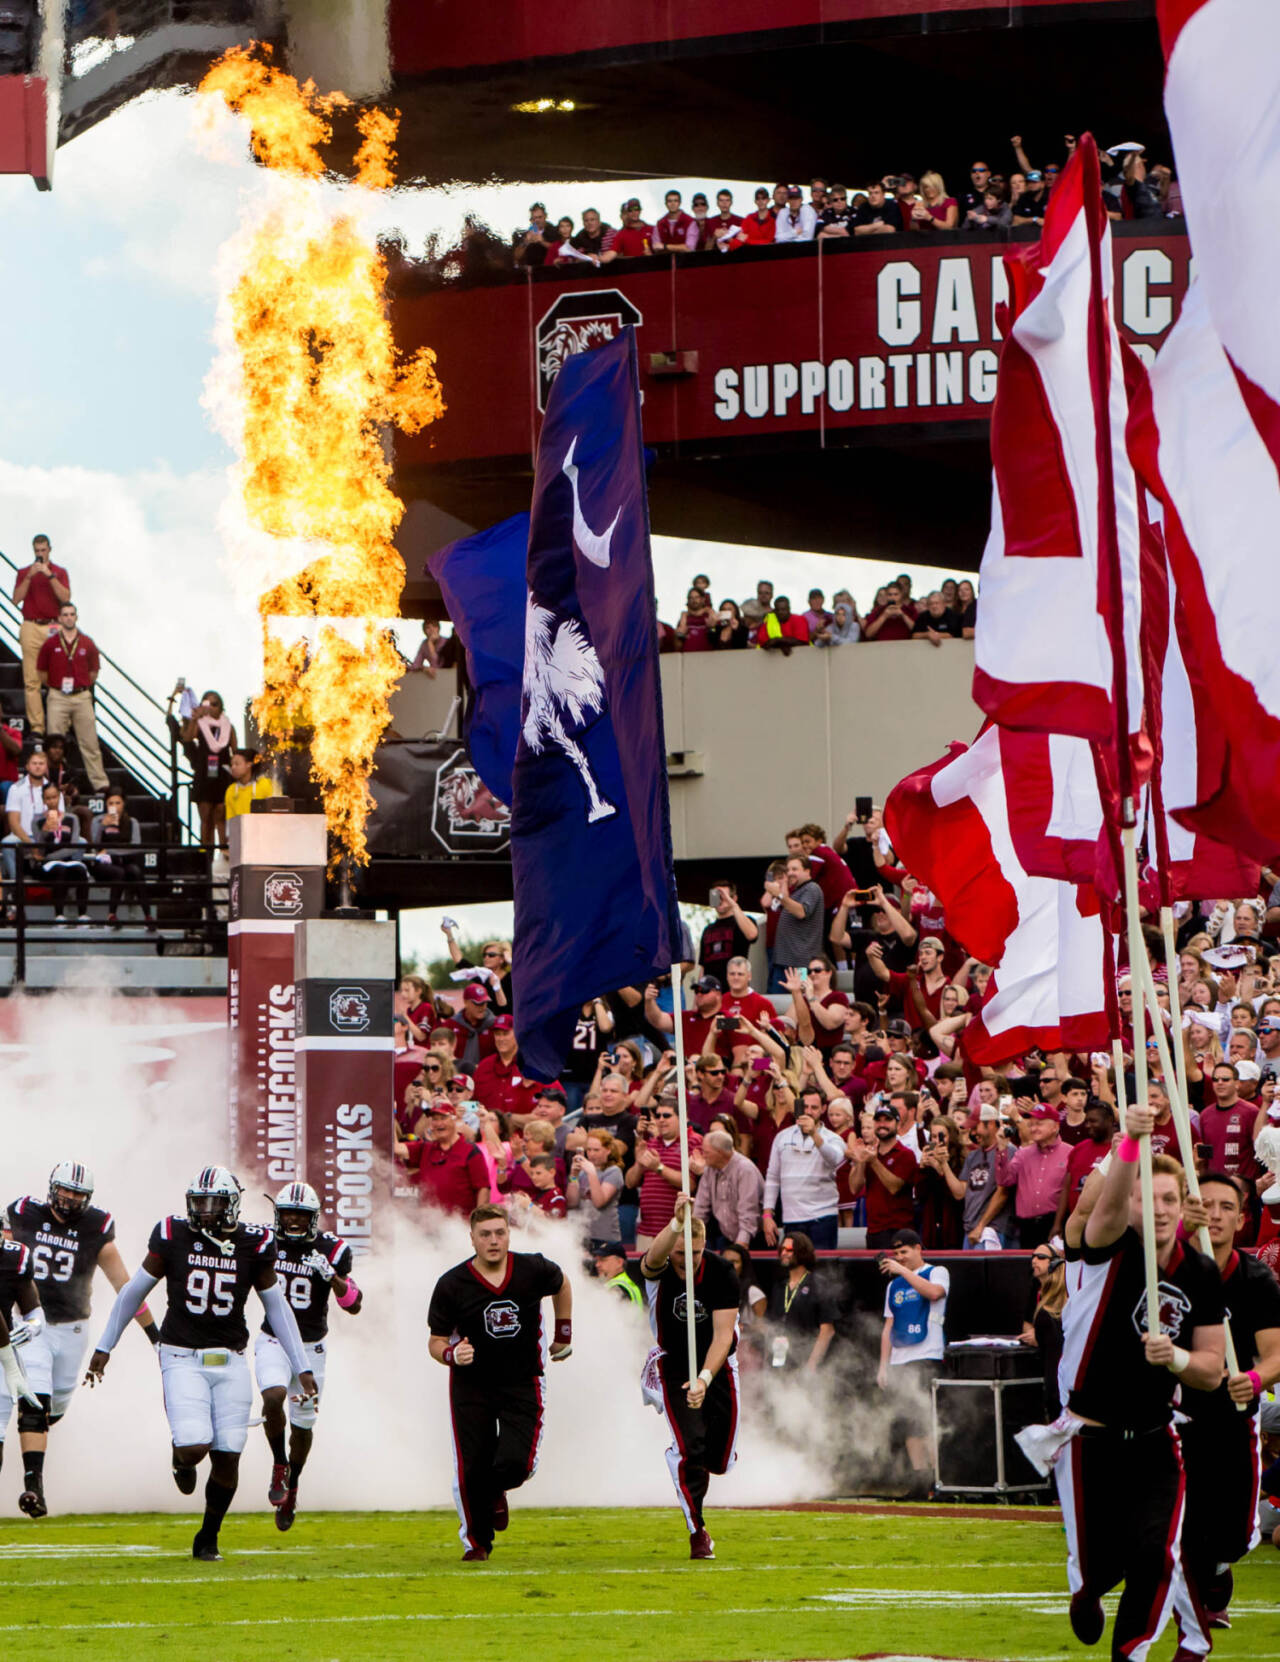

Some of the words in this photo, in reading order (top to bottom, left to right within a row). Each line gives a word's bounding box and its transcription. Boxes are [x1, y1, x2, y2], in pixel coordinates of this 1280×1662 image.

[714, 346, 999, 421] SUPPORTING
[88, 799, 104, 813] 20
[573, 1025, 596, 1050] 21
[268, 984, 295, 1181] GAMECOCKS
[35, 1230, 79, 1251] CAROLINA
[33, 1245, 75, 1282] 63
[188, 1253, 237, 1271] CAROLINA
[273, 1258, 313, 1276] AROLINA
[184, 1269, 237, 1316] 95
[908, 1323, 922, 1334] 86
